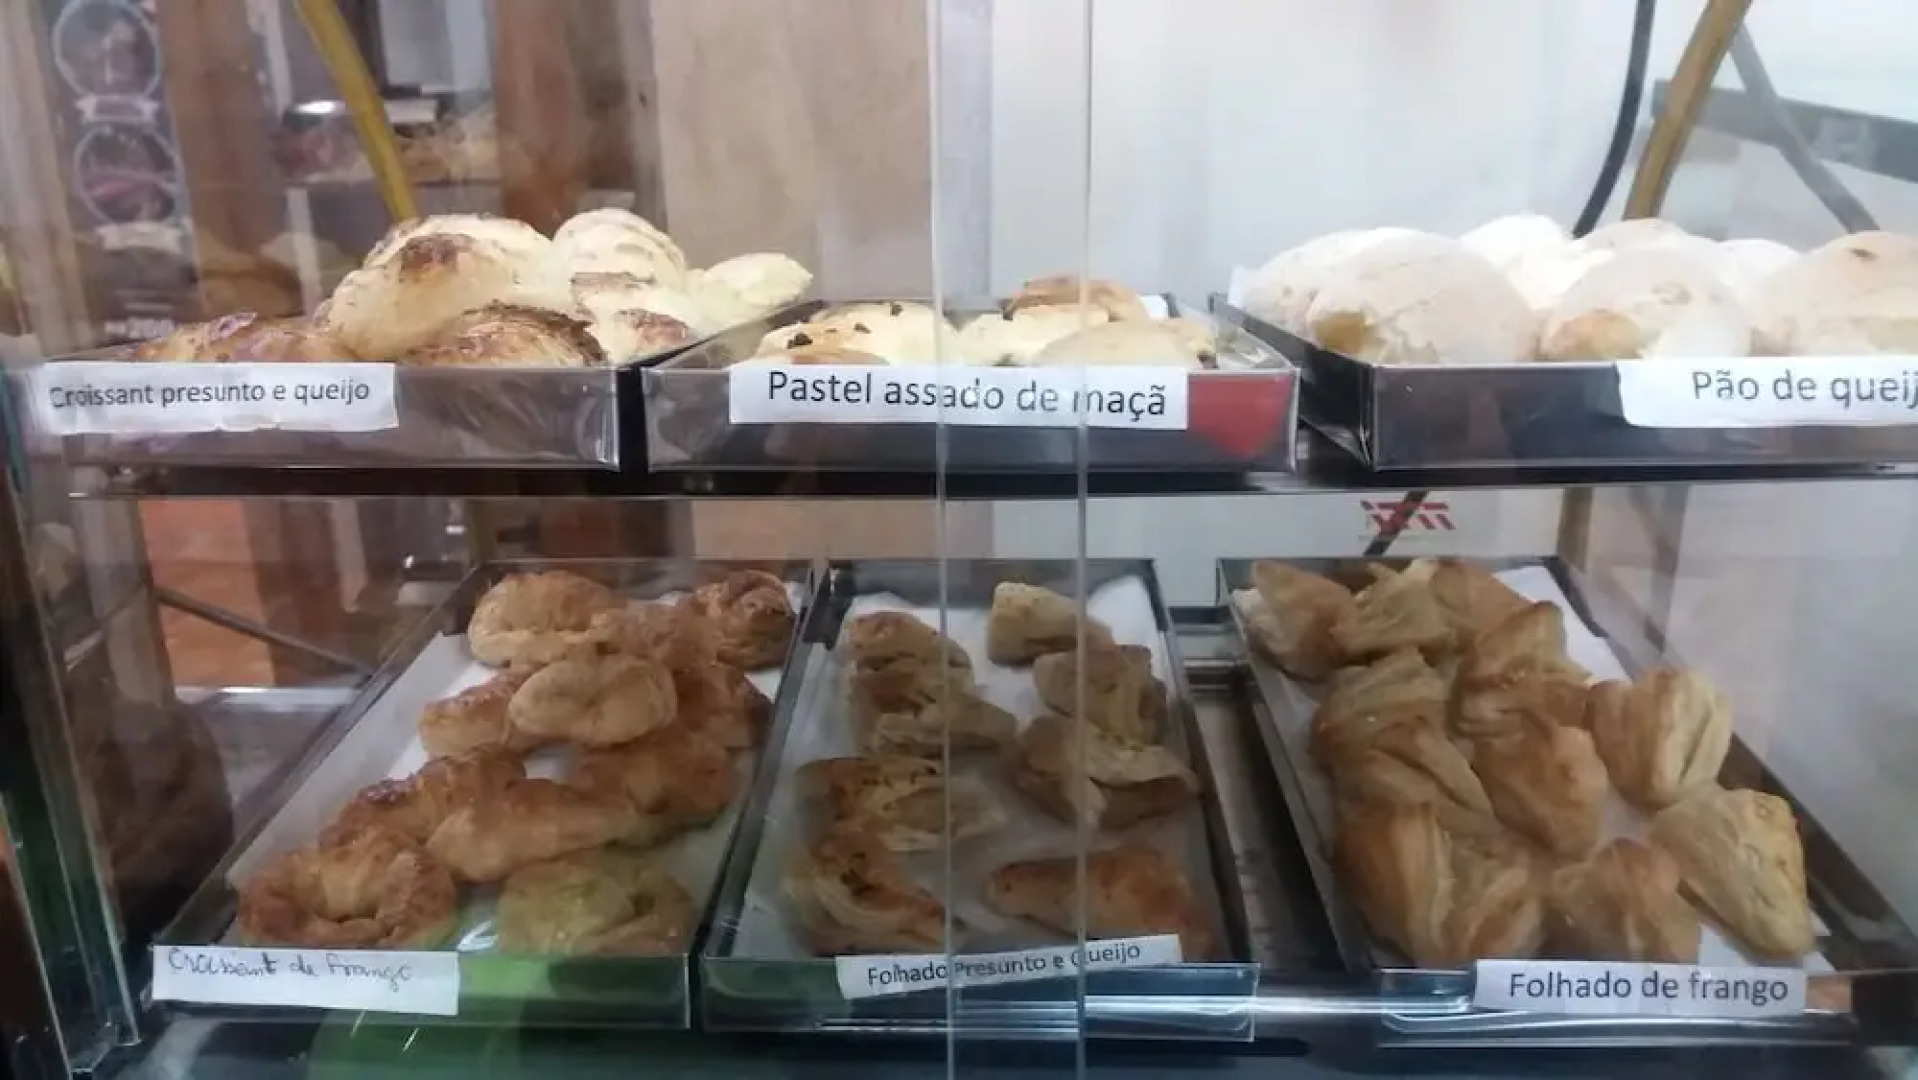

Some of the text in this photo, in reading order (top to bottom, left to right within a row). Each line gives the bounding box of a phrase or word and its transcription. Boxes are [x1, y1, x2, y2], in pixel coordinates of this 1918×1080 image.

[49, 376, 371, 409] Croissant presunto e queijo
[767, 371, 1167, 421] Pastel assado de maçã
[1692, 369, 1760, 400] Pão
[1773, 369, 1817, 400] de
[867, 963, 948, 987] Folhado
[955, 955, 1046, 978] Presunto
[1053, 954, 1065, 969] e
[1509, 971, 1788, 1006] Folhado de frango
